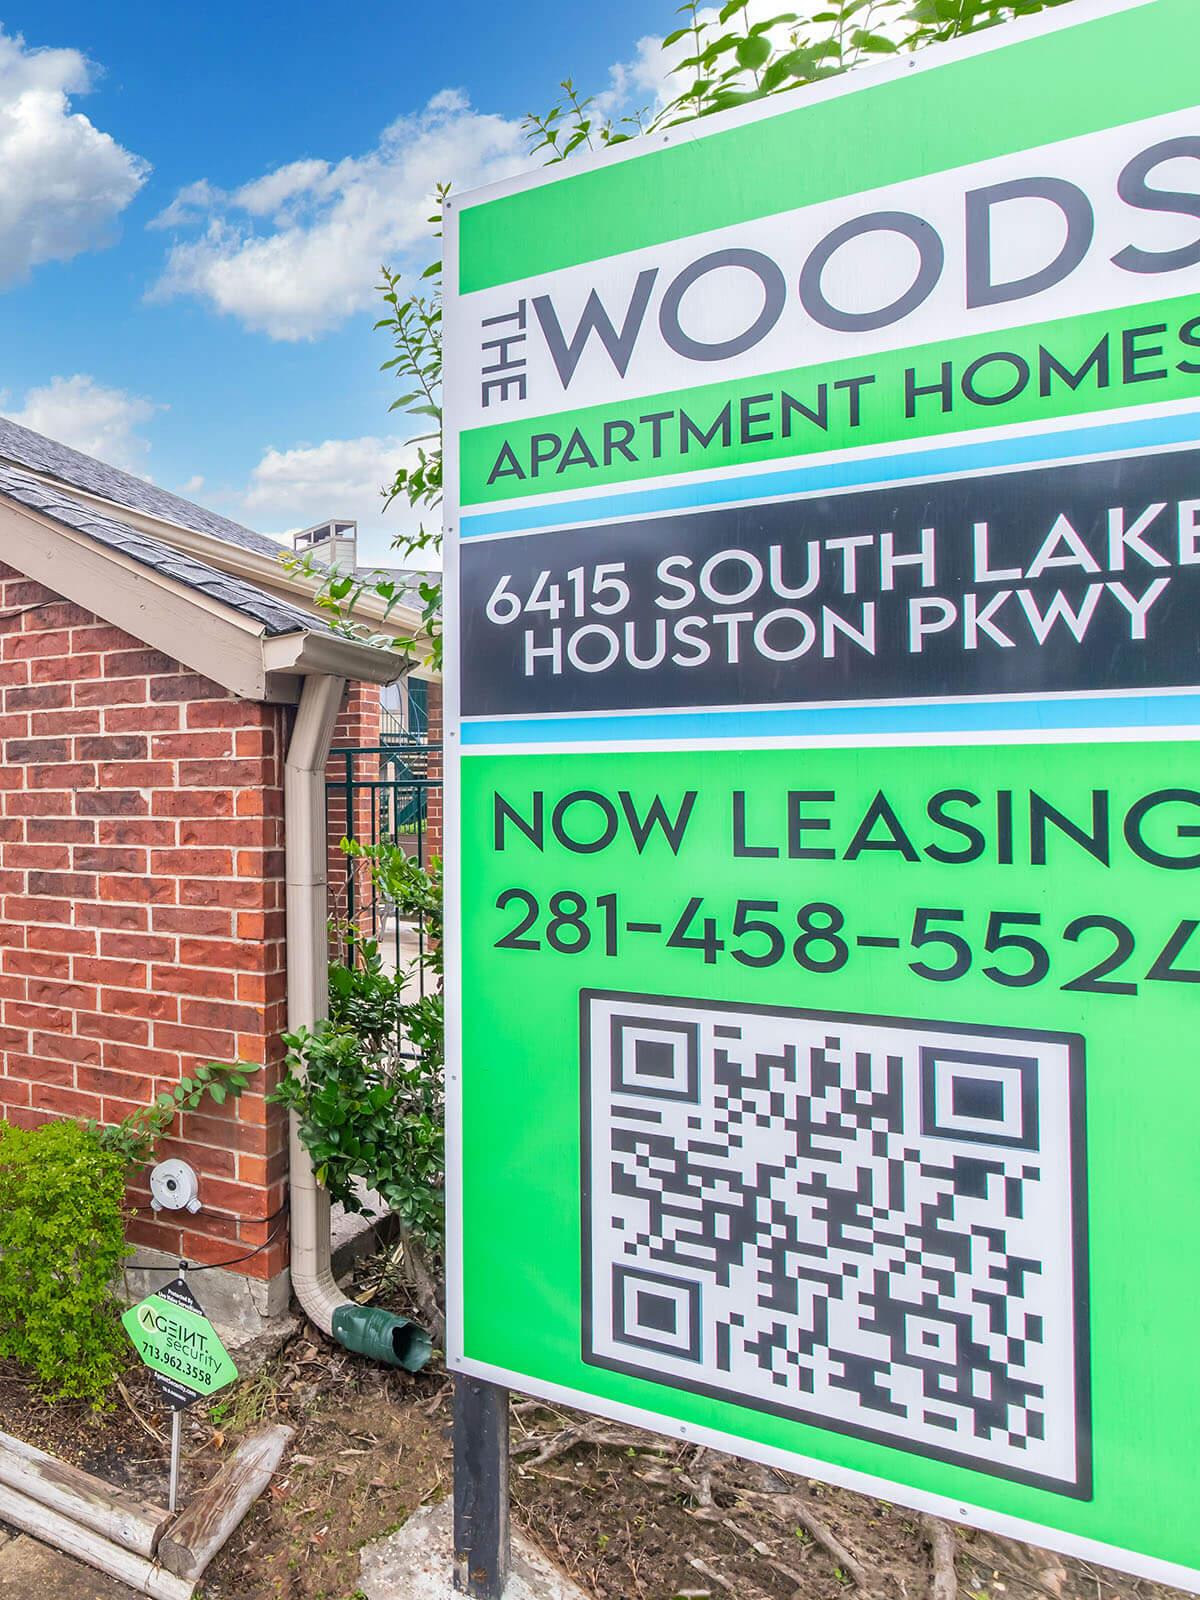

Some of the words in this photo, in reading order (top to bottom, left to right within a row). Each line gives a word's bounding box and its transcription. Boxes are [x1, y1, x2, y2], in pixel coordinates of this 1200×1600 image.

[531, 135, 1200, 391] WOODS
[481, 299, 527, 408] THE
[486, 375, 876, 485] APARTMENT
[485, 562, 631, 625] 6415
[654, 528, 935, 610] SOUTH
[524, 602, 876, 676] HOUSTON
[909, 577, 1171, 654] PKWY
[493, 790, 698, 856] NOW
[732, 788, 1200, 870] LEASING
[142, 1341, 212, 1386] 713.962.3558
[166, 1336, 222, 1374] security
